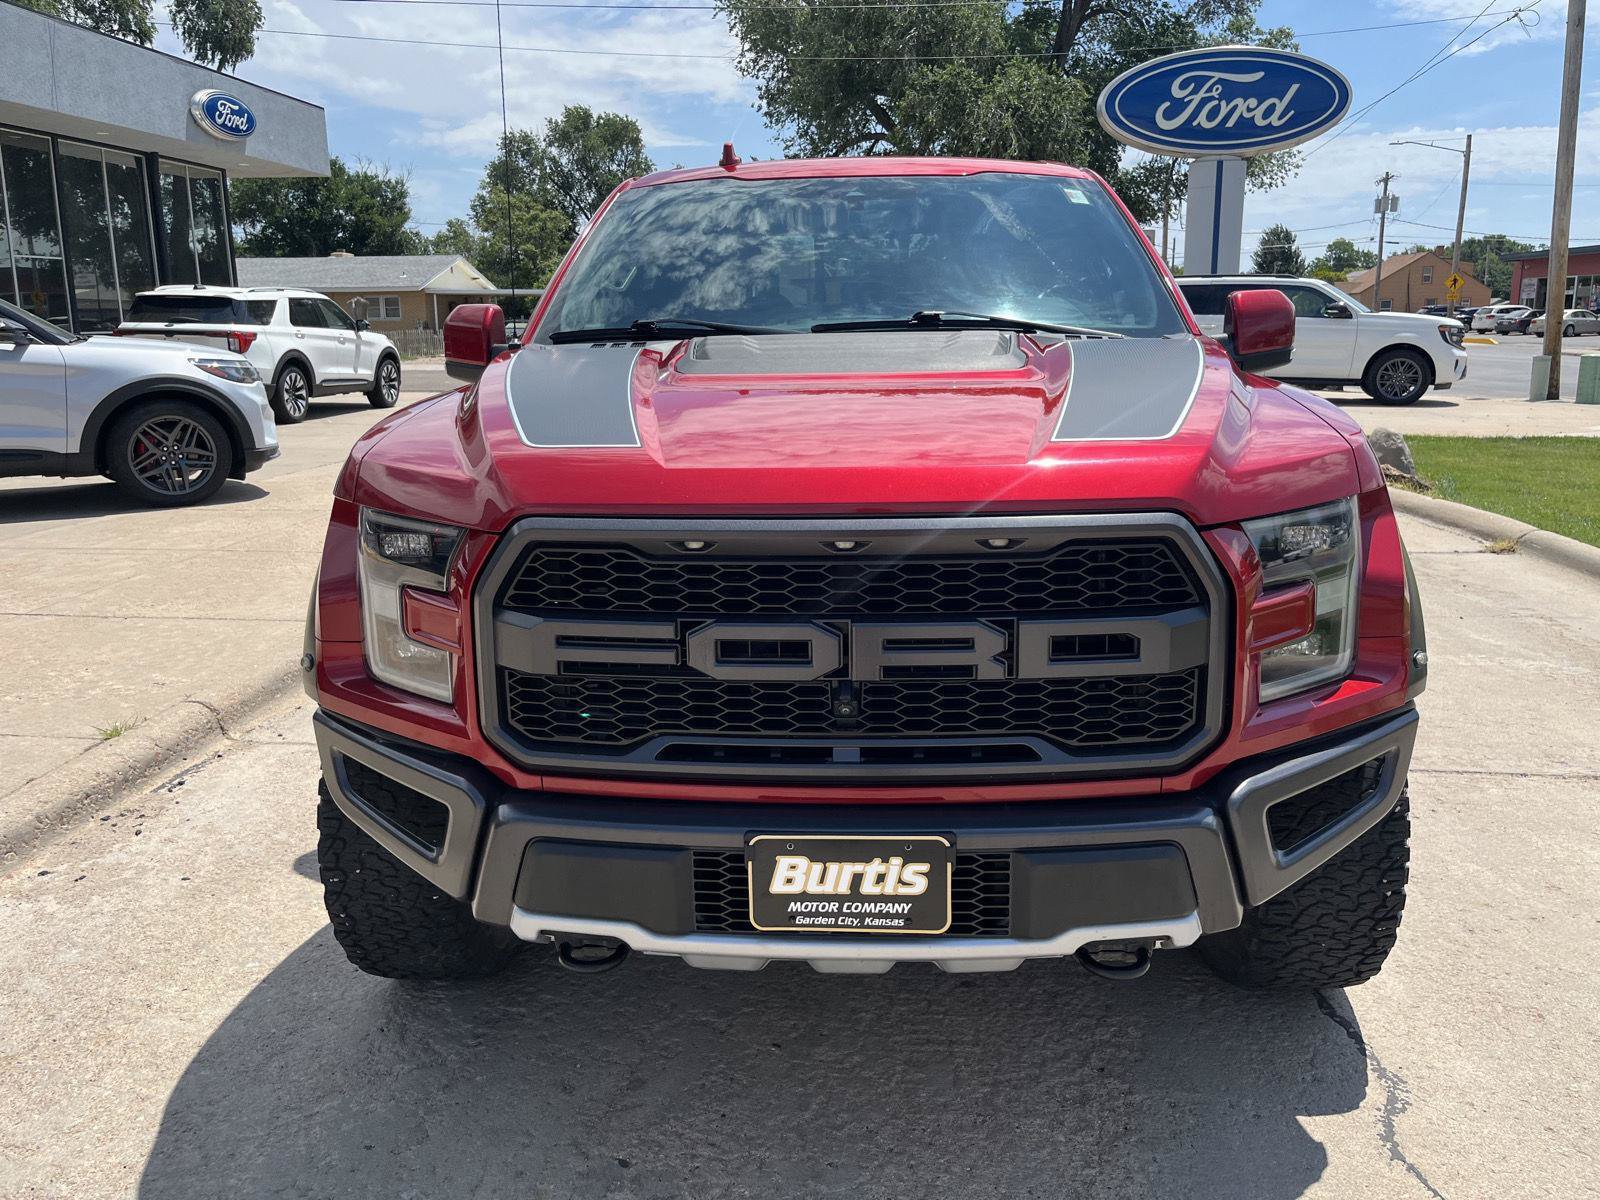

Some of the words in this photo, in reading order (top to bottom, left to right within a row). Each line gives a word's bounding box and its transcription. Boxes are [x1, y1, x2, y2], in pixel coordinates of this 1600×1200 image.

[215, 100, 248, 131] Ford
[1155, 71, 1301, 131] Ford
[497, 608, 1208, 681] FORD
[769, 855, 931, 896] Burtis
[787, 901, 839, 913] MOTOR
[842, 902, 912, 914] COMPANY
[795, 915, 836, 925] Garden
[837, 916, 861, 927] City,
[864, 917, 905, 926] Kansas
